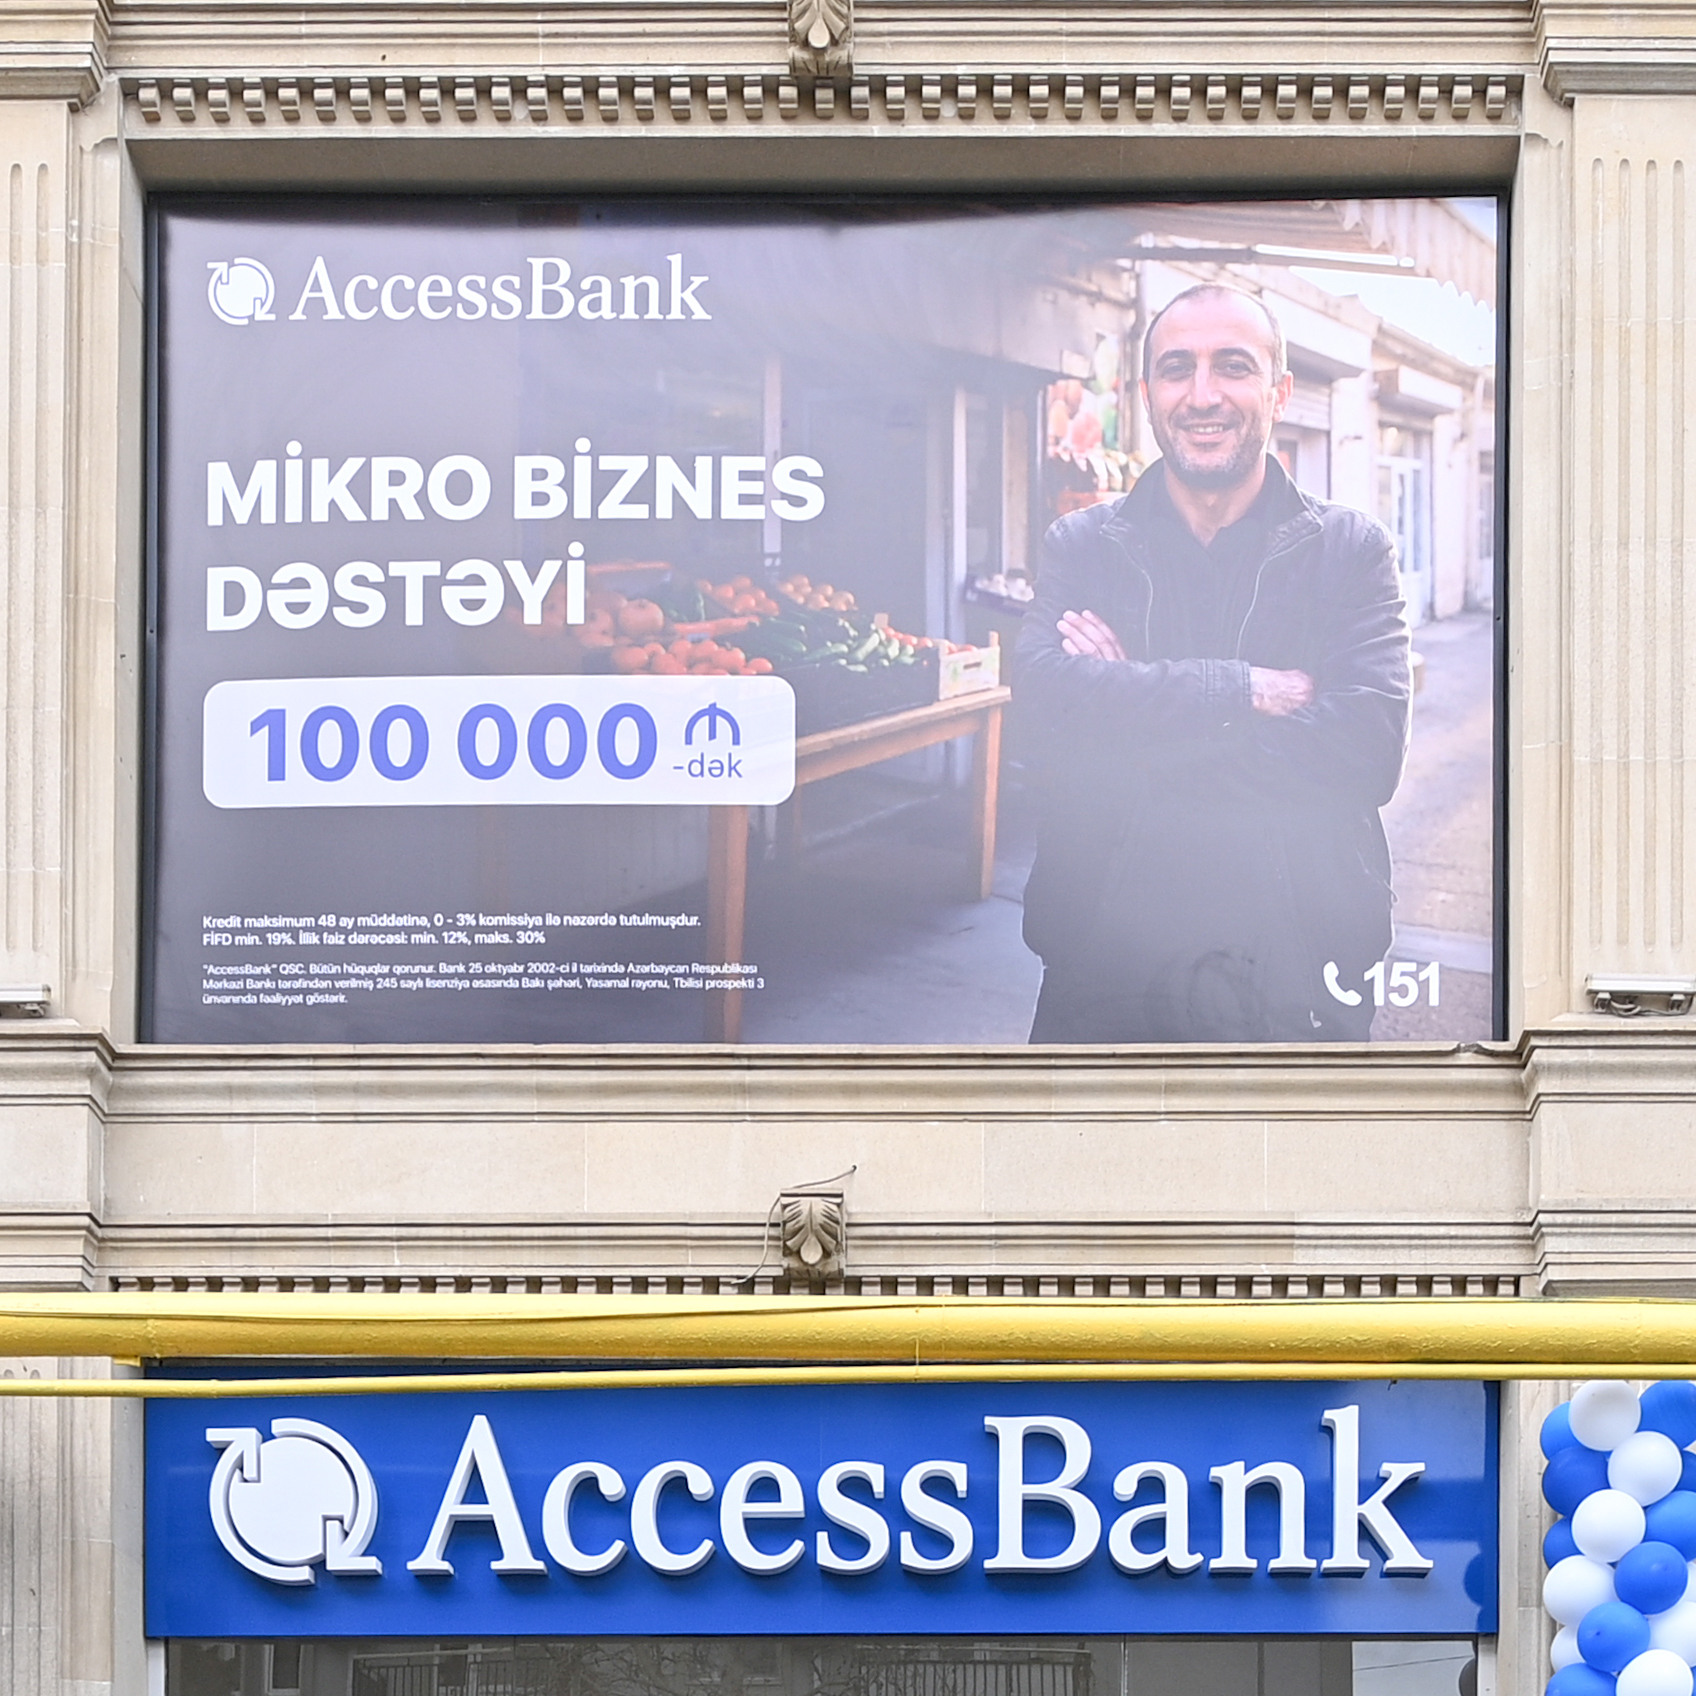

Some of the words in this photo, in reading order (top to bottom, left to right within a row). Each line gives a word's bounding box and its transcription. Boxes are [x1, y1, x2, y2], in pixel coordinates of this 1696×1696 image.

[289, 253, 712, 322] AccessBank
[207, 440, 491, 526] MİKRO
[513, 437, 825, 520] BİZNES
[206, 541, 586, 631] DƏSTƏYİ
[249, 703, 429, 782] 100
[457, 702, 658, 780] 000
[672, 752, 743, 778] -dək
[203, 915, 241, 928] Kredit
[245, 915, 315, 928] maksimum
[318, 914, 336, 927] 48
[339, 917, 354, 929] ay
[434, 914, 443, 926] 0
[456, 913, 476, 926] 3%
[479, 913, 542, 928] komissiya
[546, 913, 560, 926] ilə
[564, 913, 616, 926] nəzərdə
[235, 933, 262, 945] min.
[266, 933, 296, 945] 19%.
[323, 933, 344, 945] faiz
[411, 932, 438, 944] min.
[475, 931, 513, 944] maks.
[516, 931, 545, 944] 30%
[1364, 961, 1439, 1007] 151
[406, 1404, 1433, 1576] AccessBank
